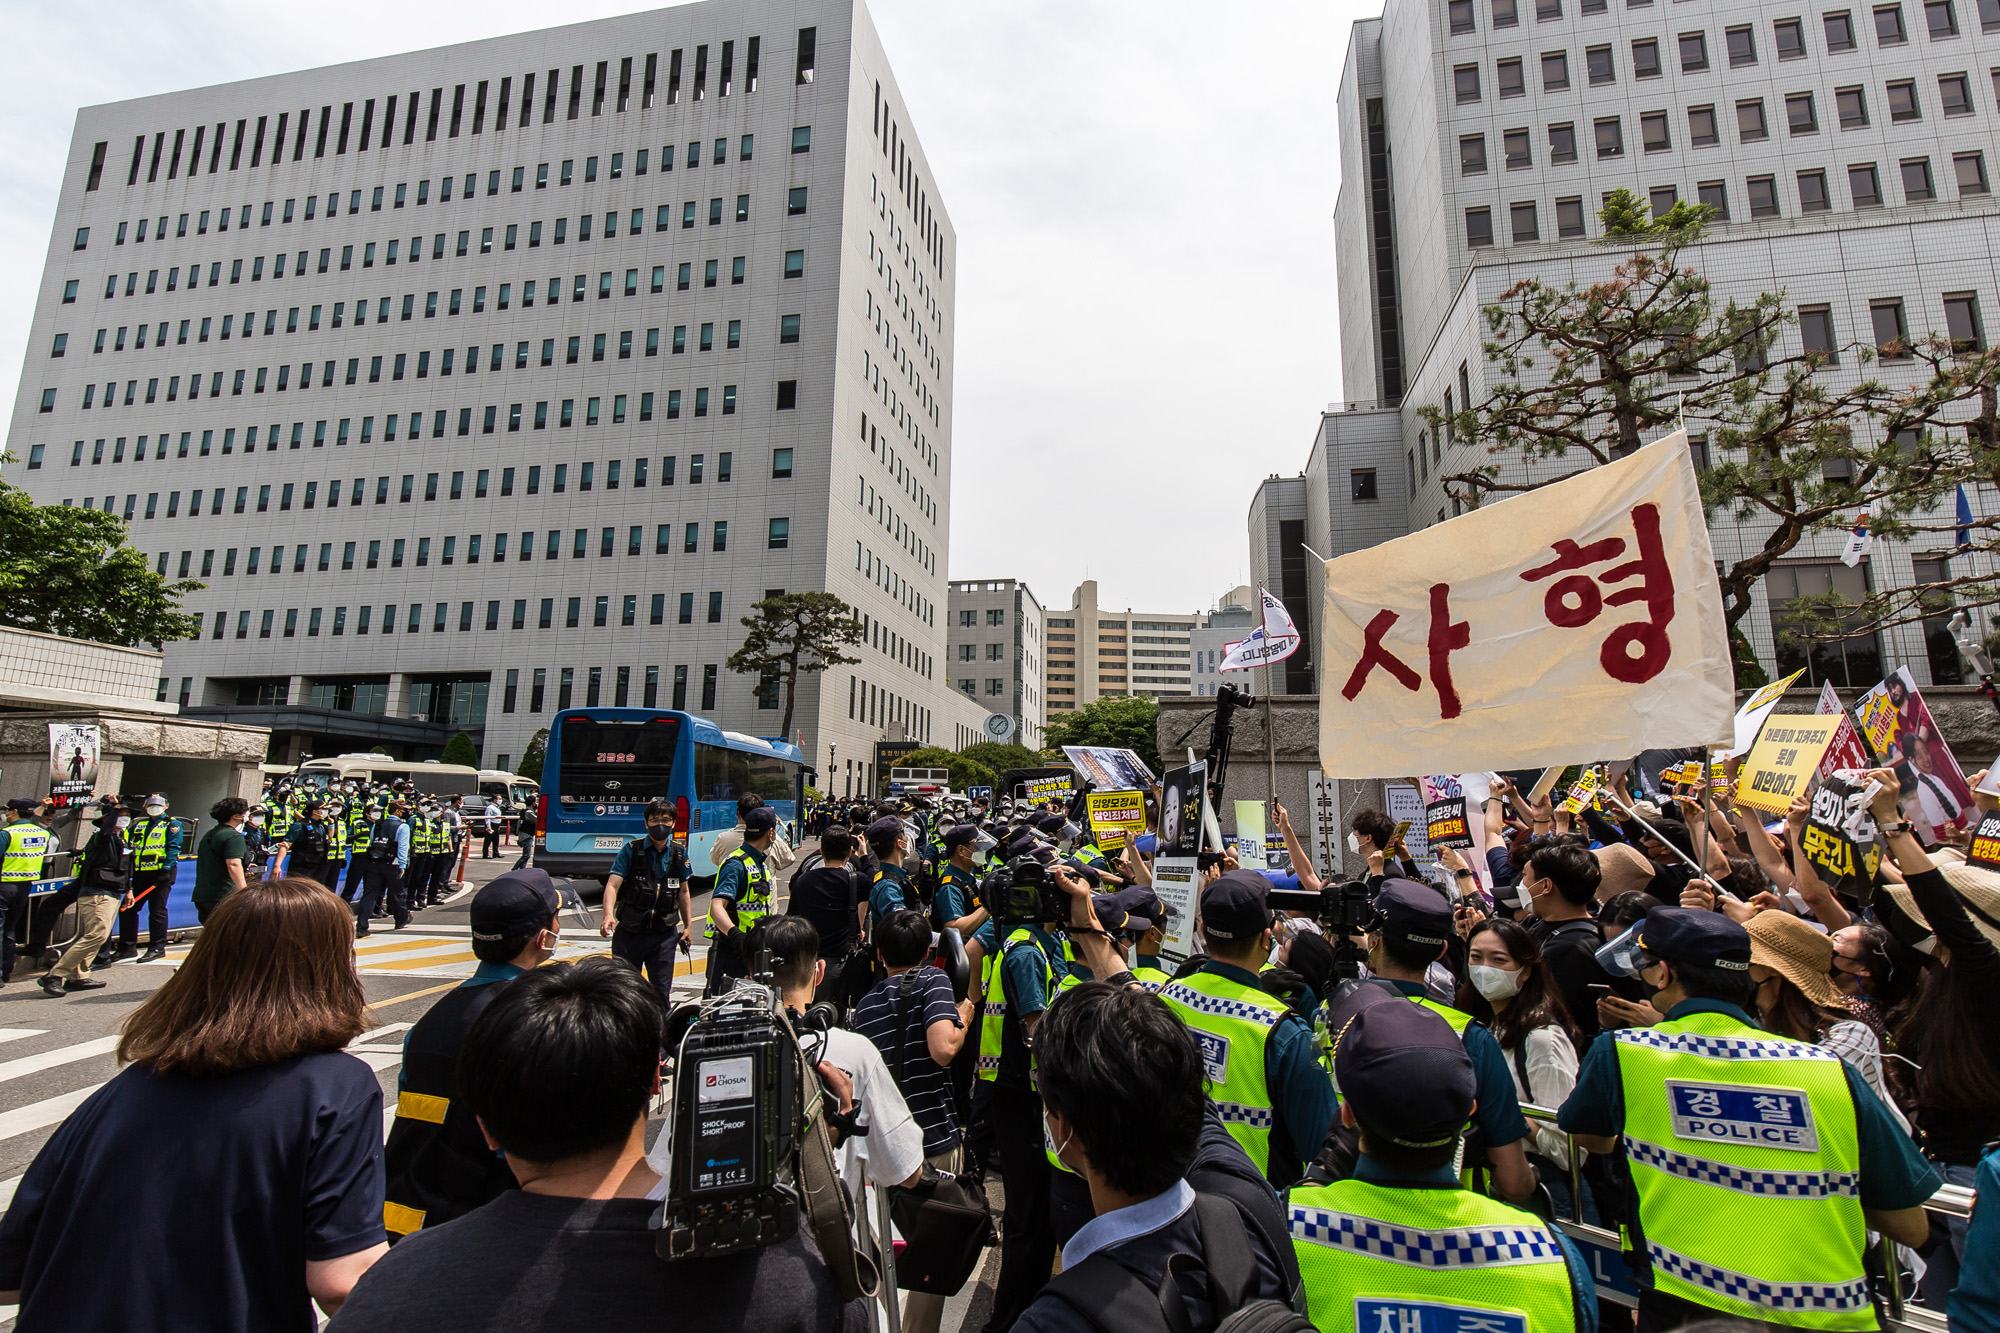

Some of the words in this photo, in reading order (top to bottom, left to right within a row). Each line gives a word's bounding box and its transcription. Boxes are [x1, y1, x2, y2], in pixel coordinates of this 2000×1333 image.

[1341, 502, 1675, 719] 사형
[1764, 728, 1796, 743] 어른들이
[1794, 730, 1828, 744] 지켜주지
[597, 753, 635, 762] 긴급호송
[1775, 748, 1798, 766] 못해
[1751, 770, 1798, 797] 미안하다.
[1092, 796, 1139, 808] 입양모장씨
[1093, 808, 1140, 821] 살인죄처벌
[1427, 803, 1462, 824] 입양모장씨
[1428, 819, 1463, 839] 법정최고형
[1803, 824, 1843, 876] 무조건
[1201, 1038, 1220, 1061] 찰
[717, 1077, 747, 1086] CHOSUN
[1684, 1089, 1793, 1124] 경찰
[702, 1120, 725, 1129] SHOCK
[702, 1128, 723, 1137] SHORT
[723, 1121, 745, 1130] PROOF
[1688, 1120, 1801, 1144] POLICE
